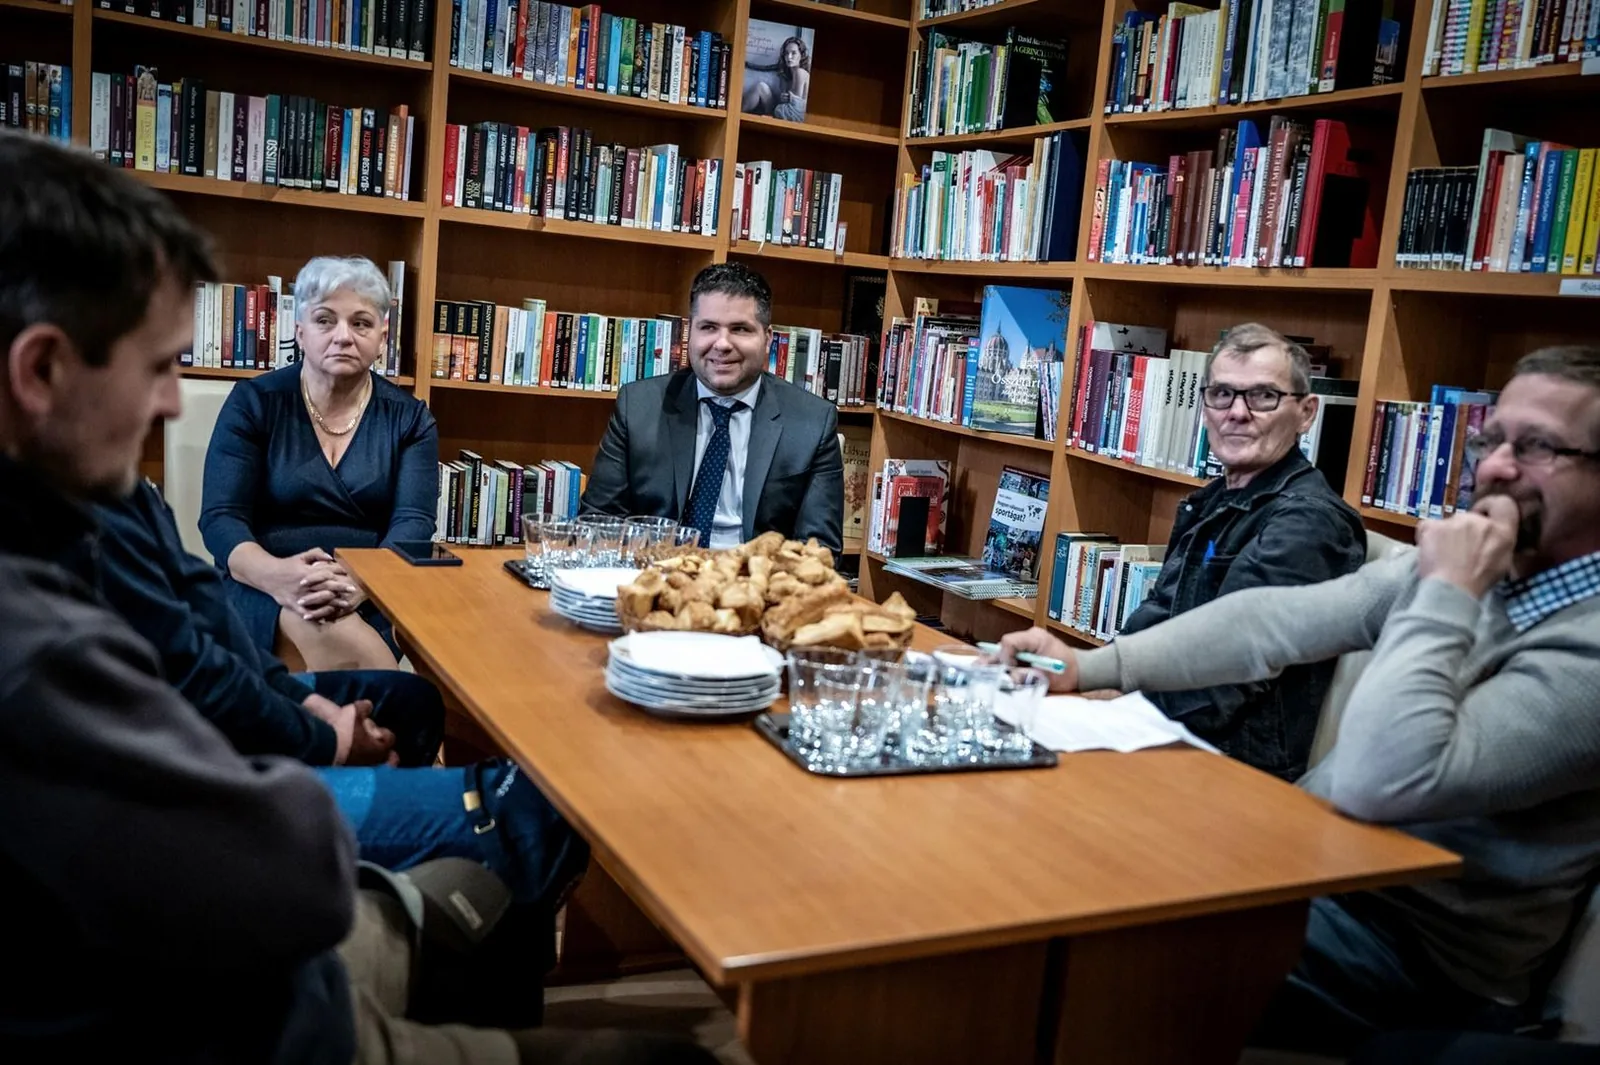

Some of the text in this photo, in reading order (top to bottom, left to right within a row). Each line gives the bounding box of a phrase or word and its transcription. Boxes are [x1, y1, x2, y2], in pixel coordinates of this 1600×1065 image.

[1018, 35, 1032, 44] David
[1269, 141, 1284, 187] EMBEREI
[704, 188, 714, 216] ENIGMA
[1265, 190, 1278, 220] MÚLT
[484, 304, 492, 332] ATLANTIS
[995, 507, 1026, 522] sportágat?
